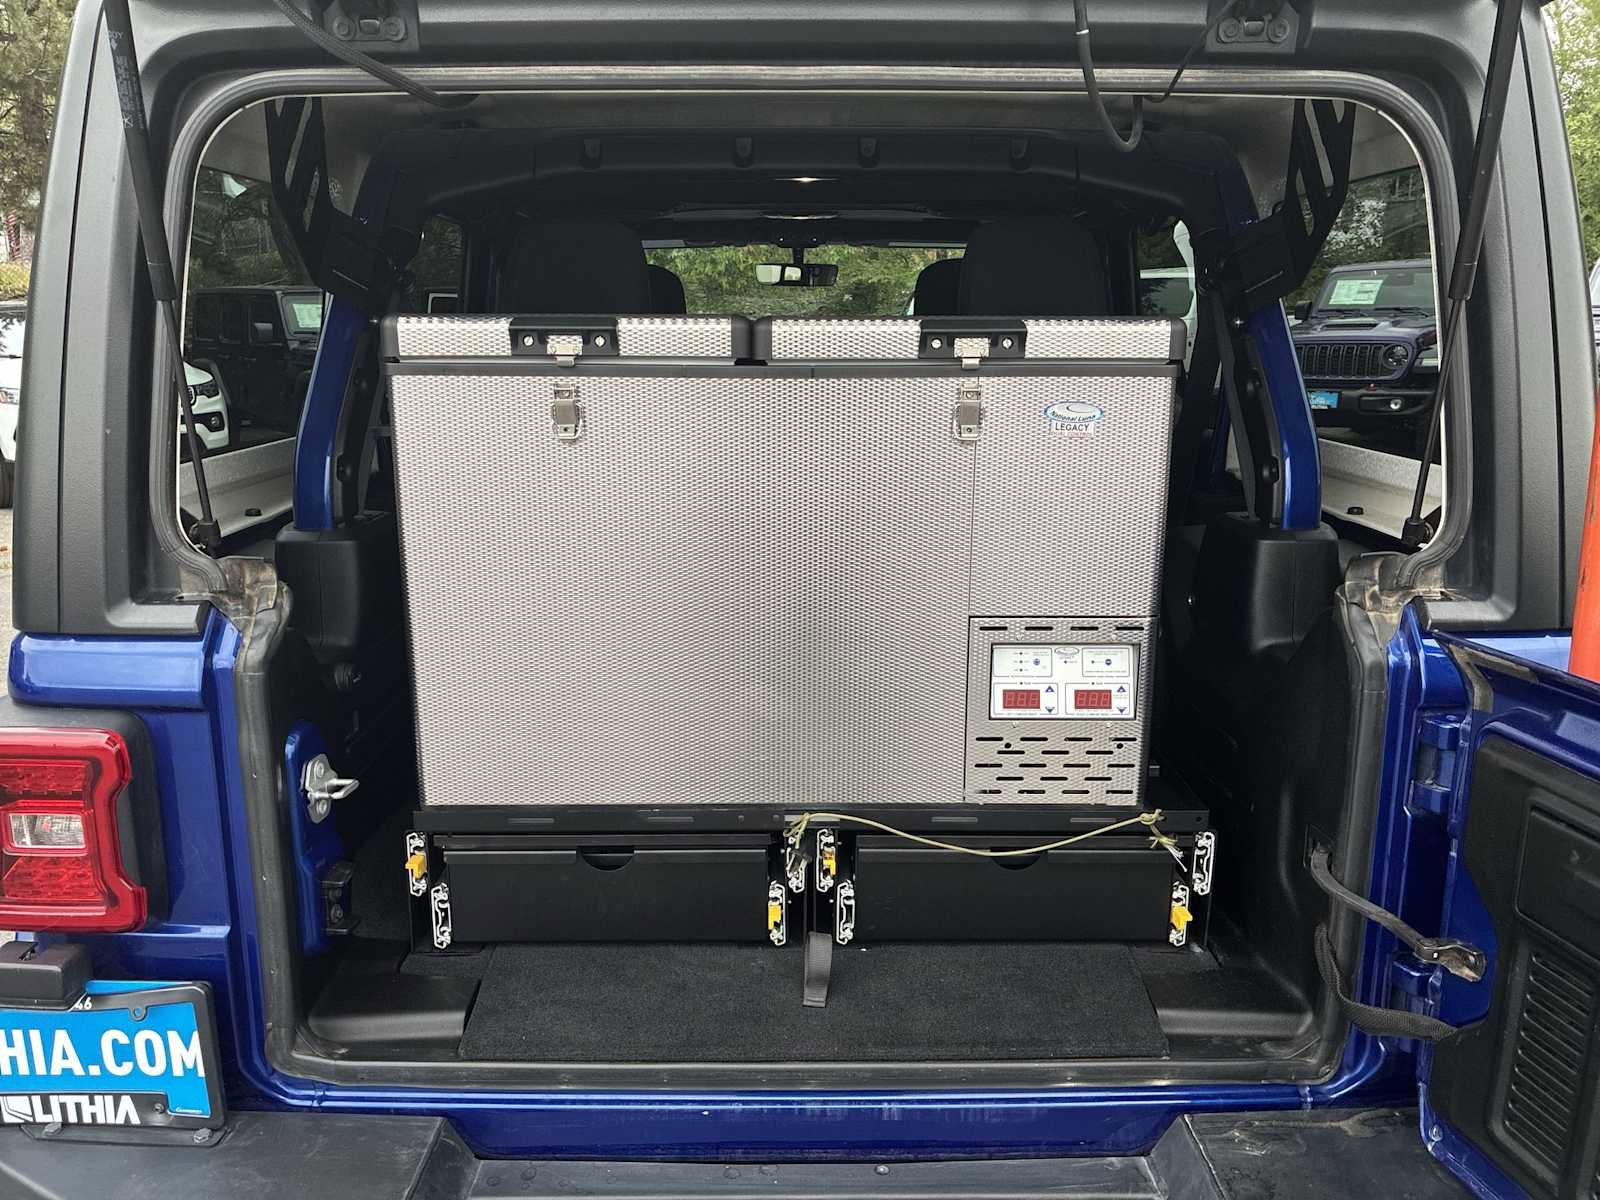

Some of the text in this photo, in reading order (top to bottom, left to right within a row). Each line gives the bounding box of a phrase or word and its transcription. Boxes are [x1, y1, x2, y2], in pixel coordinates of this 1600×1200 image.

[1051, 411, 1077, 421] National
[1055, 422, 1089, 431] LEGACY
[0, 1029, 205, 1077] HIA.COM
[31, 1094, 141, 1124] LITHIA
